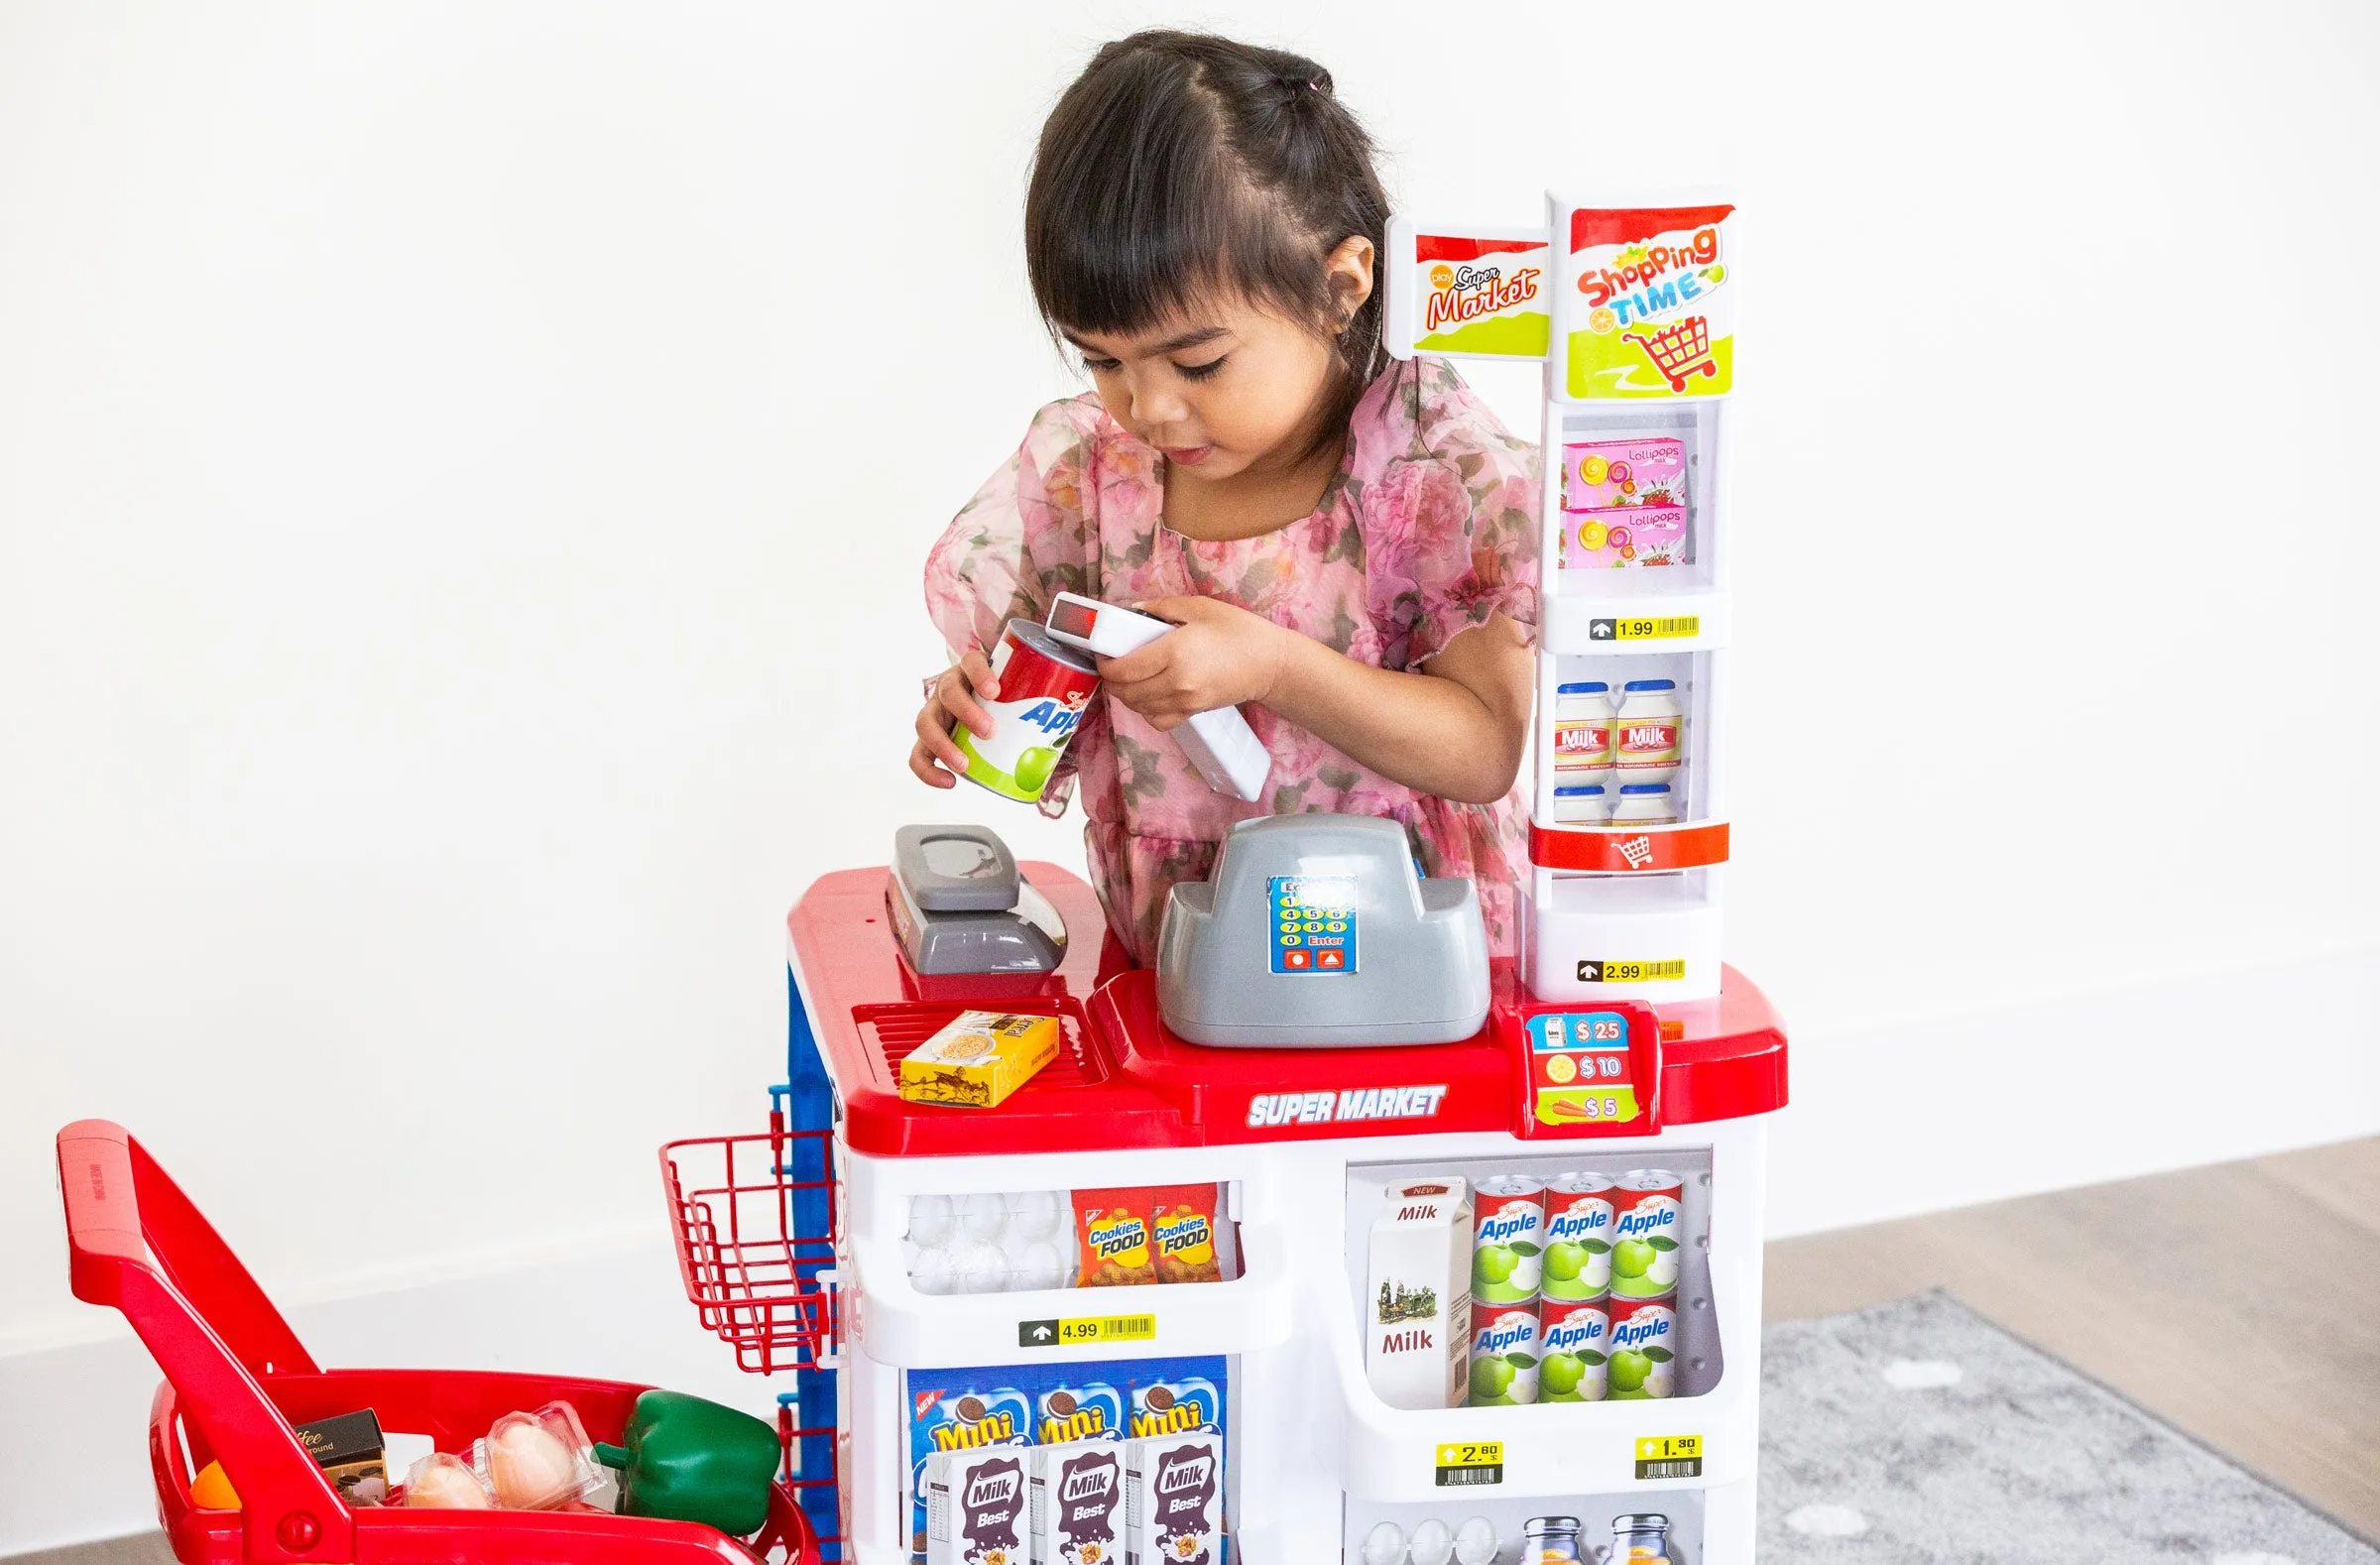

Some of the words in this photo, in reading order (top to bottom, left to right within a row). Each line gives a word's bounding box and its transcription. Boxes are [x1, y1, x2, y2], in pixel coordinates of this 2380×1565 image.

[1431, 272, 1454, 286] play
[1455, 266, 1499, 291] Super
[1427, 269, 1540, 330] Market
[1609, 272, 1703, 326] TIME
[1628, 447, 1680, 462] Lollipops
[1629, 512, 1681, 527] Lollipops
[1619, 622, 1653, 636] 1.99
[1018, 701, 1083, 735] App
[1561, 729, 1599, 748] Milk
[1628, 727, 1666, 746] Milk
[1309, 936, 1344, 945] Enter
[1606, 965, 1640, 979] 2.99
[1576, 1021, 1591, 1041] $
[1594, 1022, 1619, 1039] 25
[1580, 1056, 1595, 1078] $
[1598, 1057, 1621, 1075] 10
[1249, 1092, 1335, 1127] SUPER
[1335, 1085, 1447, 1121] MARKET
[1585, 1097, 1600, 1118] $
[1605, 1098, 1617, 1116] 5
[1413, 1186, 1437, 1195] NEW
[1397, 1205, 1438, 1221] Milk
[1550, 1211, 1607, 1238] Apple
[1617, 1208, 1675, 1236] Apple
[1091, 1221, 1141, 1244] Cookies
[1154, 1218, 1204, 1241] Cookies
[1479, 1214, 1537, 1241] Apple
[1101, 1232, 1145, 1258] FOOD
[1164, 1228, 1209, 1254] FOOD
[1063, 1323, 1098, 1338] 4.99
[1382, 1330, 1433, 1354] Milk
[1476, 1325, 1532, 1352] Apple
[1545, 1321, 1603, 1348] Apple
[1612, 1318, 1670, 1346] Apple
[916, 1391, 935, 1416] NEW
[1038, 1408, 1104, 1445] Mini
[1131, 1403, 1201, 1437] Mini
[297, 1430, 323, 1446] ffee
[935, 1413, 1012, 1452] Mini
[308, 1442, 334, 1455] round
[1069, 1473, 1108, 1498] Milk
[1165, 1466, 1204, 1490] Milk
[973, 1479, 1012, 1504] Milk
[1073, 1504, 1106, 1521] Best
[1169, 1495, 1201, 1513] Best
[977, 1510, 1010, 1528] Best
